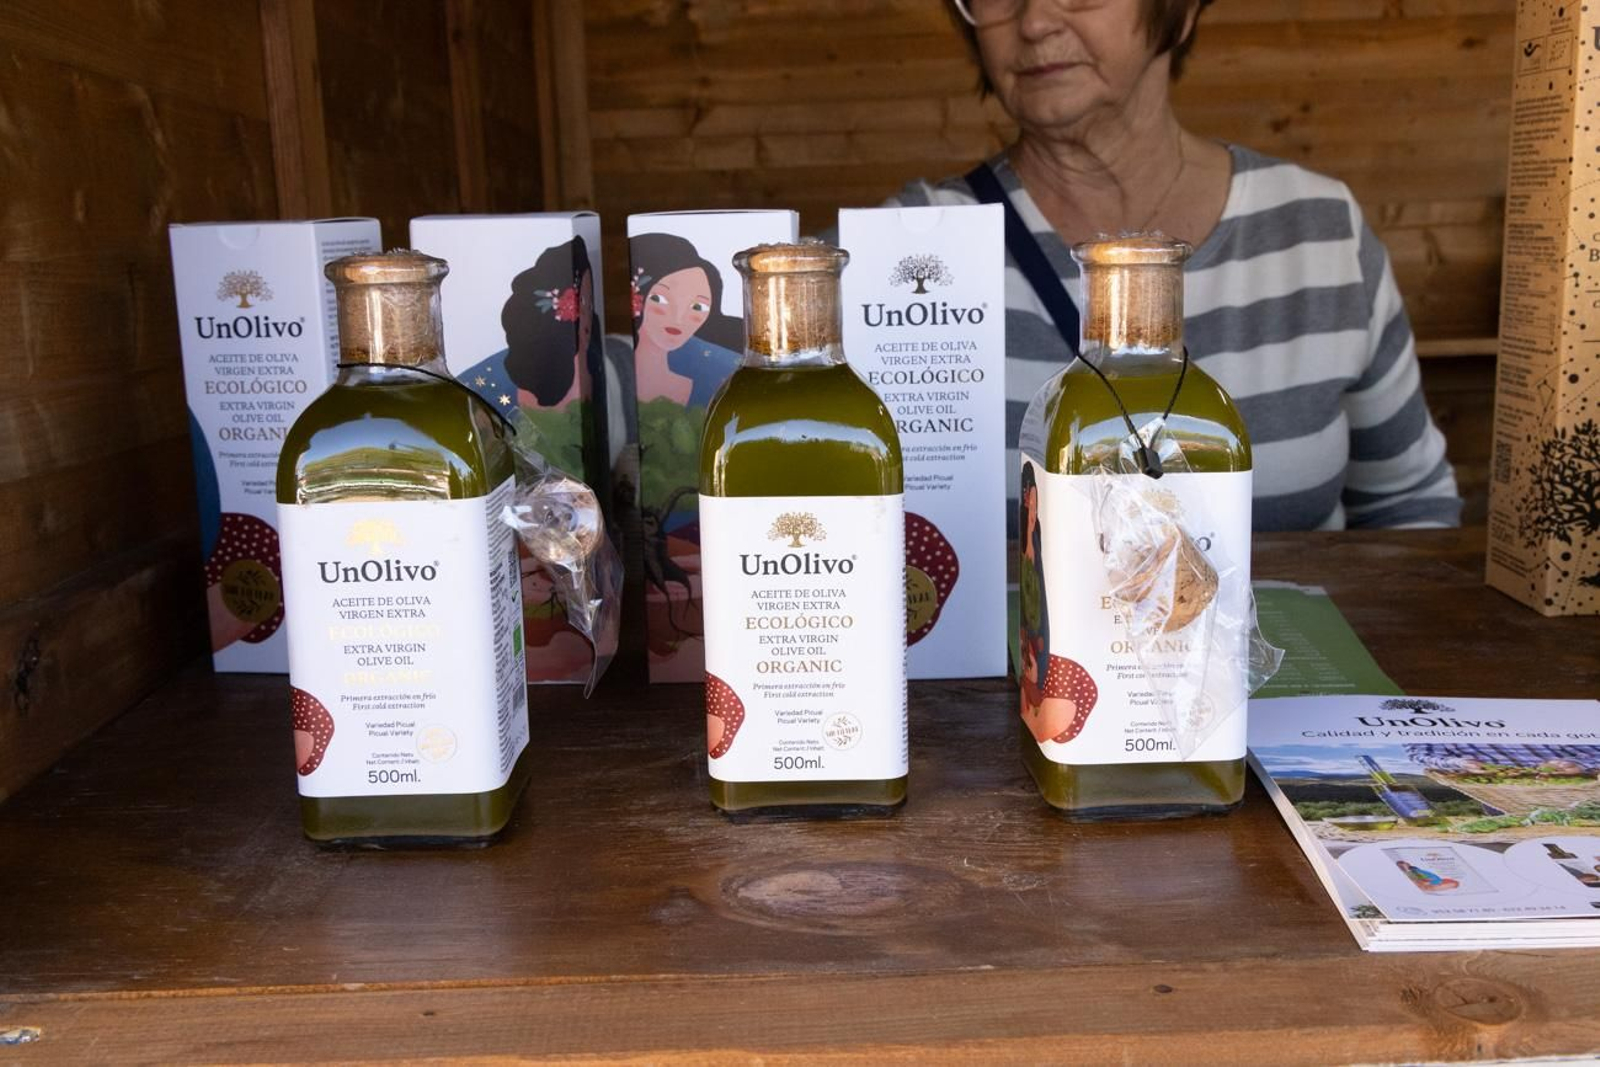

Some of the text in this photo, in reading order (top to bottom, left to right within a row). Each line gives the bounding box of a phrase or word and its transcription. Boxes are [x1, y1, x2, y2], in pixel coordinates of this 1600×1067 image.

[861, 301, 984, 327] UnOlivo
[195, 316, 303, 339] UnOlivo
[874, 341, 977, 353] ACEITE DE OLIVA
[209, 353, 299, 363] ACEITE DE OLIVA
[881, 355, 971, 366] VIRGEN EXTRA
[215, 366, 294, 375] VIRGEN EXTRA
[868, 366, 984, 385] ECOLÓGICO
[205, 377, 307, 394] ECOLÓGICO
[884, 391, 970, 402] EXTRA VIRGIN
[220, 401, 295, 411] EXTRA VIRGIN
[897, 405, 956, 415] OLIVE OIL
[232, 414, 285, 423] OLIVE OIL
[896, 418, 974, 434] RGANIC
[219, 427, 287, 441] ORGANI
[739, 553, 854, 575] UnOlivo
[317, 560, 437, 583] UnOlivo
[751, 589, 846, 599] ACEITE DE OLIVA
[332, 596, 431, 608] ACEITE DE OLIVA
[757, 601, 840, 610] VIRGEN EXTRA
[339, 609, 426, 619] VIRGEN EXTRA
[746, 613, 853, 630] ECOLÓGICO
[759, 634, 838, 644] EXTRA VIRGIN
[344, 643, 426, 654] EXTRA VIRGIN
[771, 647, 826, 656] OLIVE OIL
[357, 655, 414, 666] OLIVE OIL
[756, 659, 842, 673] ORGANIC
[1355, 716, 1506, 728] UnOlivo
[1301, 730, 1375, 738] Calidad
[1381, 730, 1392, 738] y
[1398, 730, 1480, 738] tradición
[1566, 731, 1600, 739] got
[1125, 738, 1176, 752] 500ml.
[774, 756, 825, 770] 500ml.
[368, 769, 421, 783] 500ml.
